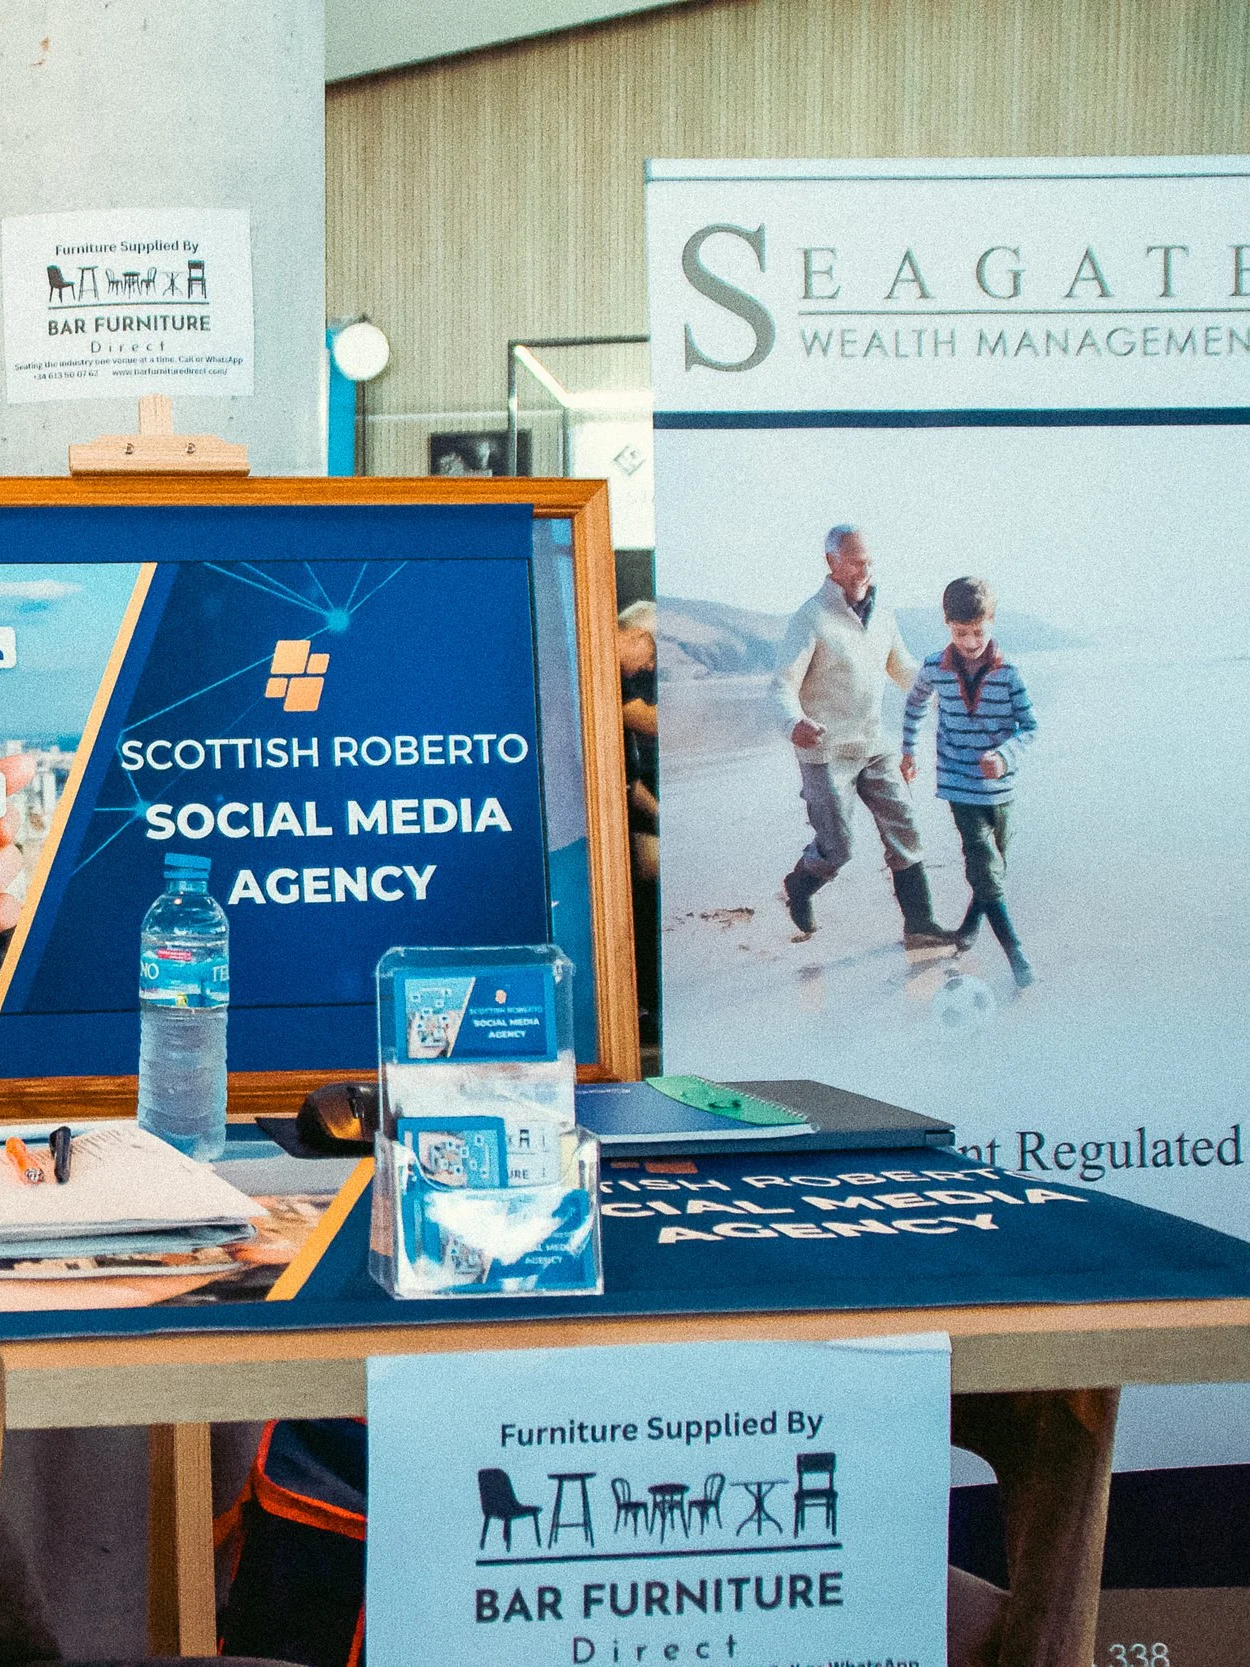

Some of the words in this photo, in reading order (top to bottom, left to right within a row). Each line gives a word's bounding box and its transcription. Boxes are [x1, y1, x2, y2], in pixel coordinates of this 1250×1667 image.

[55, 242, 116, 256] Furniture
[120, 239, 179, 255] Supplied
[183, 239, 199, 254] By
[48, 318, 86, 336] BAR
[94, 314, 211, 334] FURNITURE
[91, 340, 166, 354] Direct
[799, 326, 956, 359] WEALTH
[14, 362, 43, 371] Seating
[45, 360, 58, 368] the
[59, 358, 93, 368] industry
[120, 735, 320, 771] SCOTTISH
[333, 732, 529, 767] ROBERTO
[146, 800, 333, 841] SOCIAL
[347, 796, 513, 836] MEDIA
[227, 863, 438, 906] AGENCY
[473, 1018, 507, 1028] SOCIAL
[509, 1017, 541, 1026] MEDIA
[488, 1030, 526, 1039] AGENCY
[1016, 1125, 1246, 1181] Regulated
[801, 1187, 1090, 1211] MEDIA
[658, 1213, 1000, 1245] AGENCY
[500, 1418, 639, 1448] Furniture
[647, 1410, 778, 1445] Supplied
[787, 1409, 824, 1439] By
[475, 1585, 563, 1625] BAR
[583, 1571, 844, 1619] FURNITURE
[572, 1634, 738, 1665] Direct
